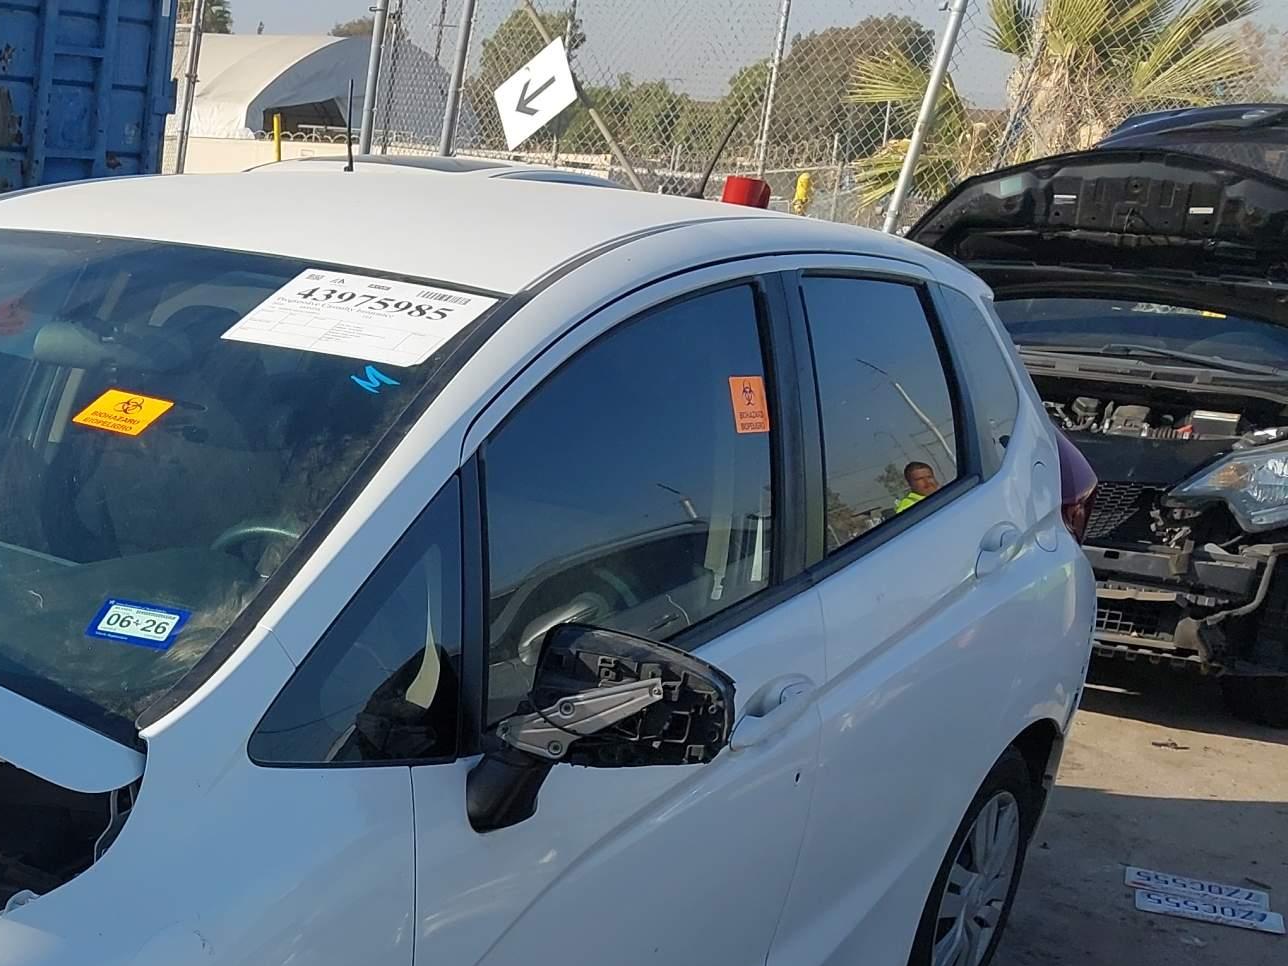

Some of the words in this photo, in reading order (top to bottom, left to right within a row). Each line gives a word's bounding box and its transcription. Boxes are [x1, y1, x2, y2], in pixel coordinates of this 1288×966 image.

[296, 286, 454, 321] 43975985
[106, 613, 134, 628] 06
[140, 619, 170, 634] 26
